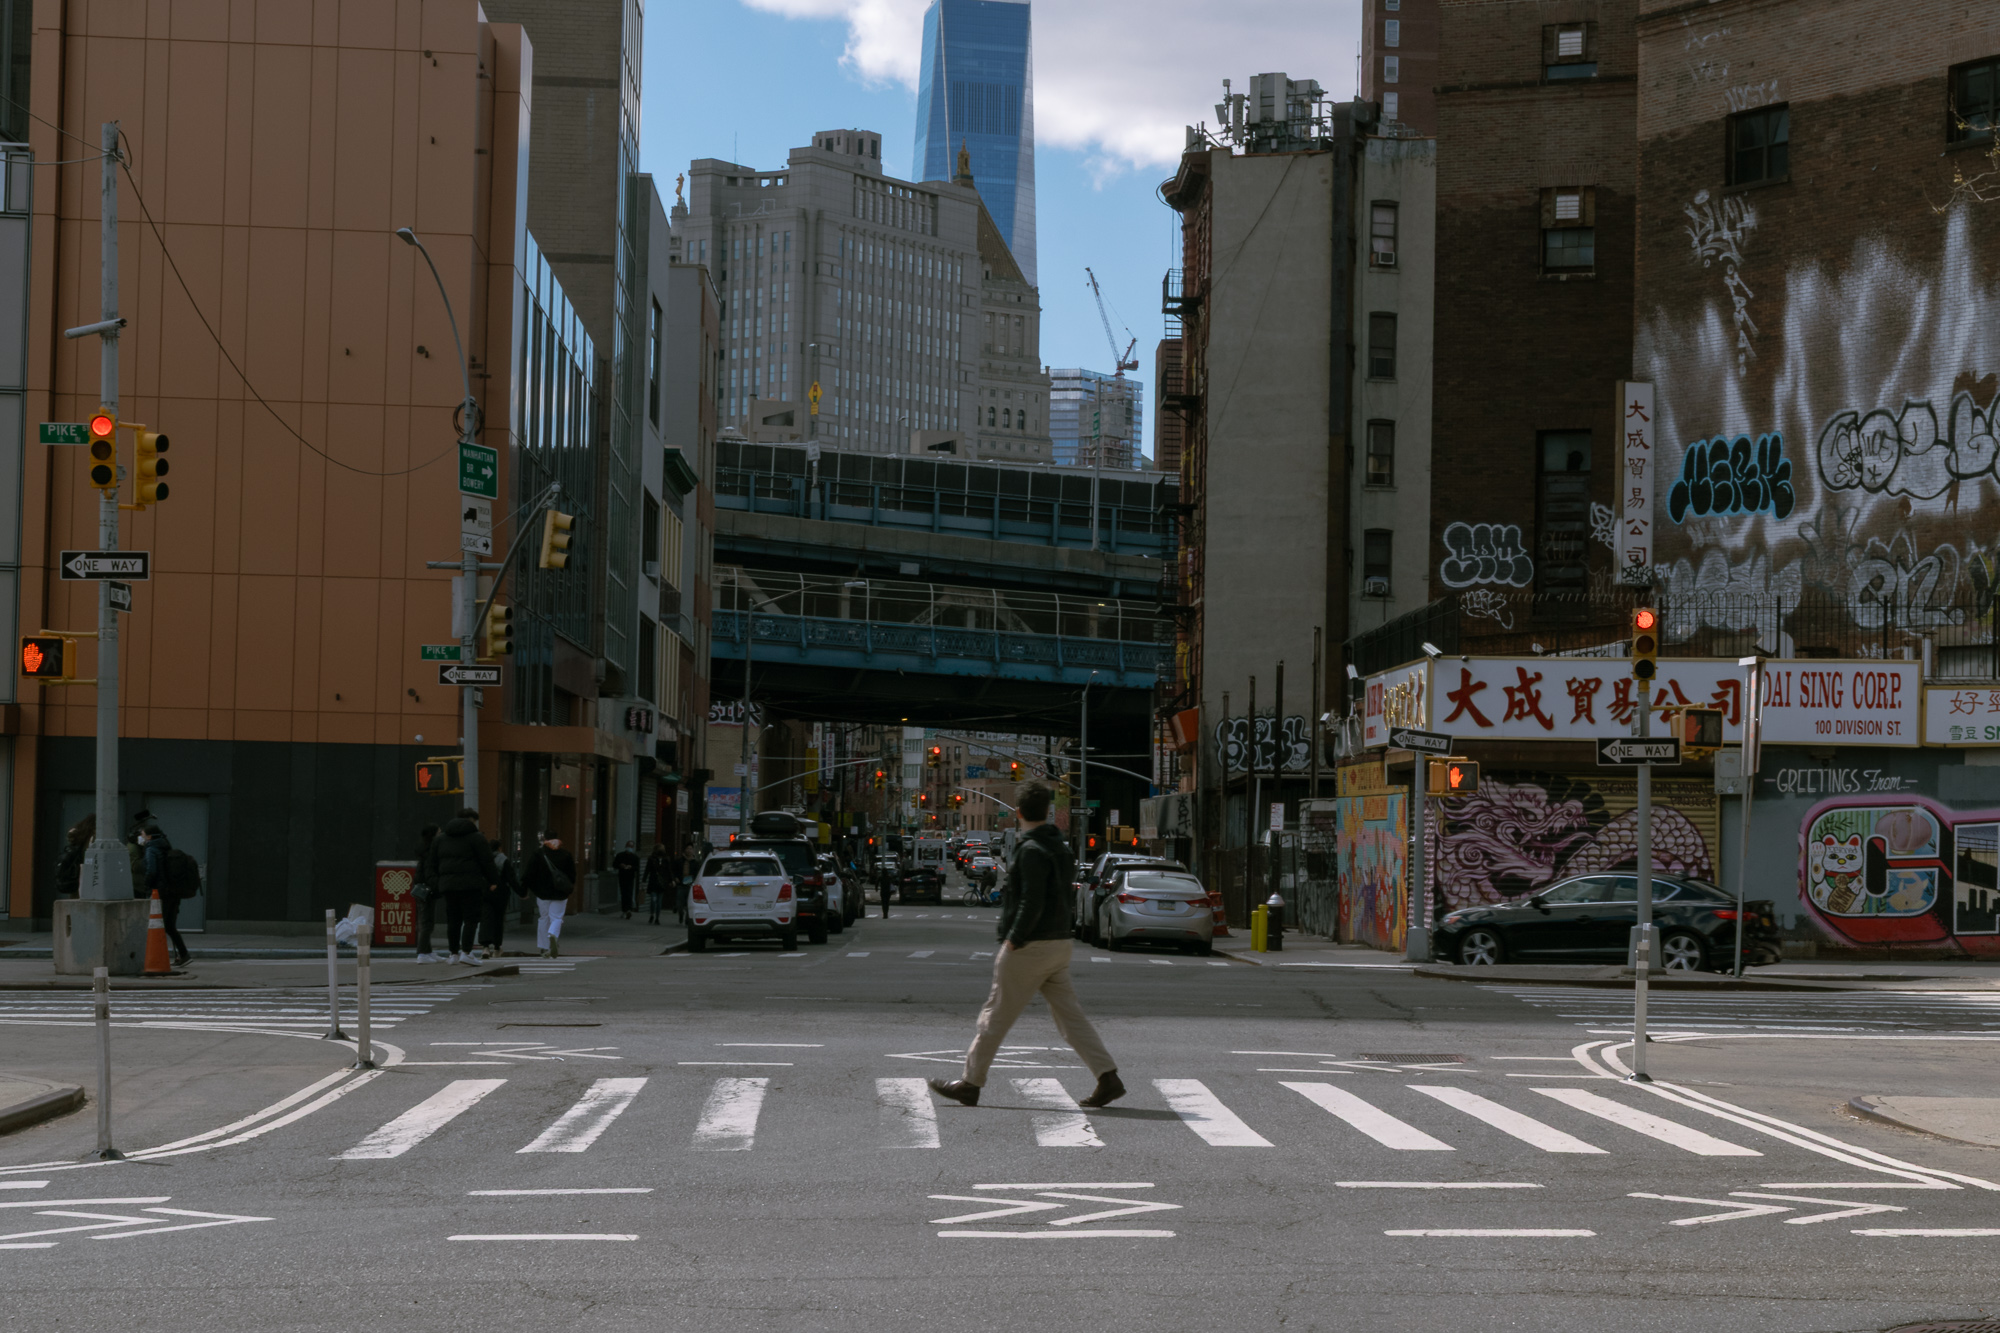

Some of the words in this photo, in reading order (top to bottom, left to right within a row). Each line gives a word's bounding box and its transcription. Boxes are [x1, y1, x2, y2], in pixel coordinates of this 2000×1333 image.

[48, 425, 78, 436] PIKE
[463, 447, 494, 464] MANHATTAN
[463, 477, 485, 491] BOWERY
[1625, 400, 1650, 567] 大成貿易公司
[478, 506, 490, 516] TRUCK
[478, 519, 491, 530] ROUTE
[463, 537, 479, 549] LOCAL
[75, 560, 99, 571] ONE
[111, 560, 137, 571] WAY
[427, 646, 446, 655] PIKE
[449, 671, 467, 679] ONE
[474, 671, 493, 680] WAY
[1800, 671, 1844, 709] SING
[1852, 671, 1902, 709] CORP.
[1815, 720, 1832, 735] 100
[1836, 720, 1882, 735] DIVISION
[1886, 720, 1902, 736] ST.
[1949, 725, 1978, 741] 雪豆
[1399, 734, 1416, 745] ONE
[1425, 738, 1443, 748] WAY
[1611, 745, 1633, 757] ONE
[1644, 746, 1669, 757] WAY
[1777, 768, 1861, 793] GREETINGS
[381, 902, 400, 910] SHOW
[381, 911, 412, 925] LOVE
[391, 926, 412, 934] CLEAN
